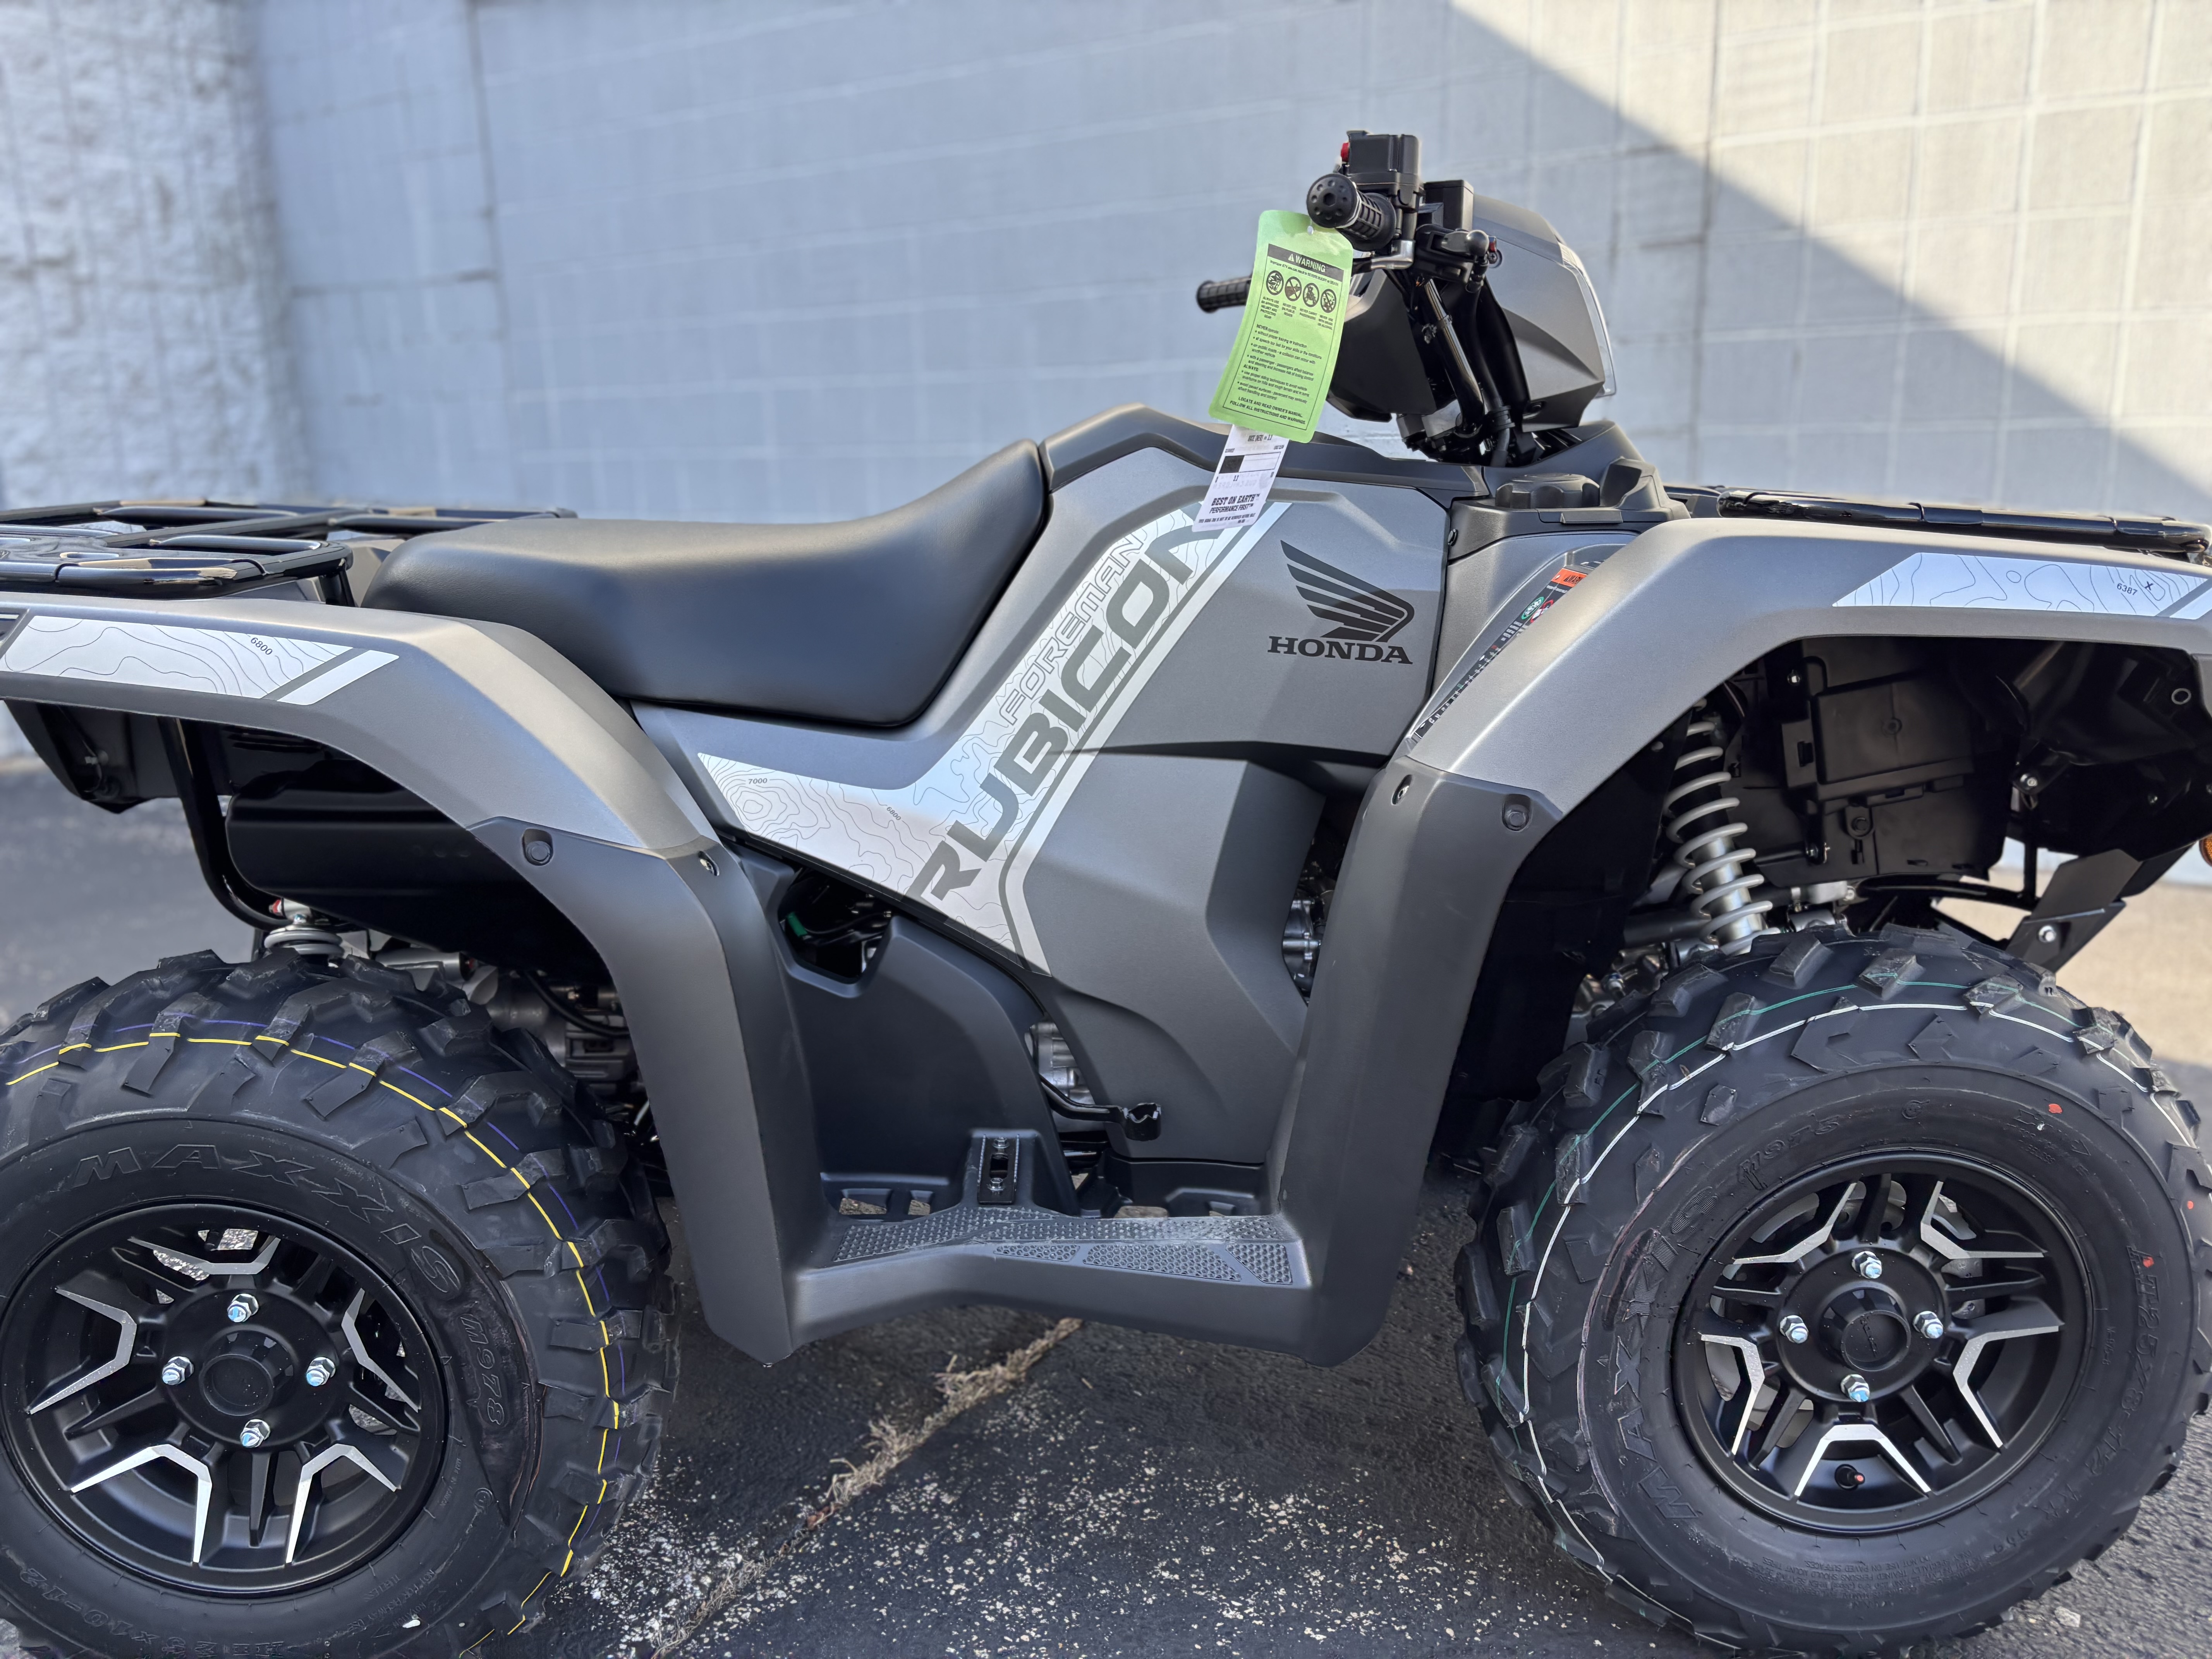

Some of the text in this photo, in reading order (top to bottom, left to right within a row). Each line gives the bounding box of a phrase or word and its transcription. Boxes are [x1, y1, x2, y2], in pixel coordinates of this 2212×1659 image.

[1296, 255, 1326, 273] WARNING
[1254, 407, 1279, 417] INSTRUCTIONS
[1211, 497, 1228, 506] BEST
[1228, 496, 1237, 504] ON
[1209, 505, 1239, 514] PERFORMANCE
[2117, 583, 2138, 595] 6387
[1000, 534, 1144, 726] FOREMAN
[250, 636, 273, 657] 6800
[1267, 635, 1413, 665] HONDA
[905, 502, 1226, 906] RUBICON
[886, 806, 901, 821] 6800
[72, 1144, 462, 1294] MAXXIS
[1614, 1186, 1718, 1518] MAXXIS
[460, 1313, 507, 1427] M978
[1886, 1562, 1899, 1570] USE
[1902, 1556, 1917, 1567] NOT
[1810, 1571, 1837, 1580] SHOULD
[1876, 1570, 1907, 1580] TRAINED
